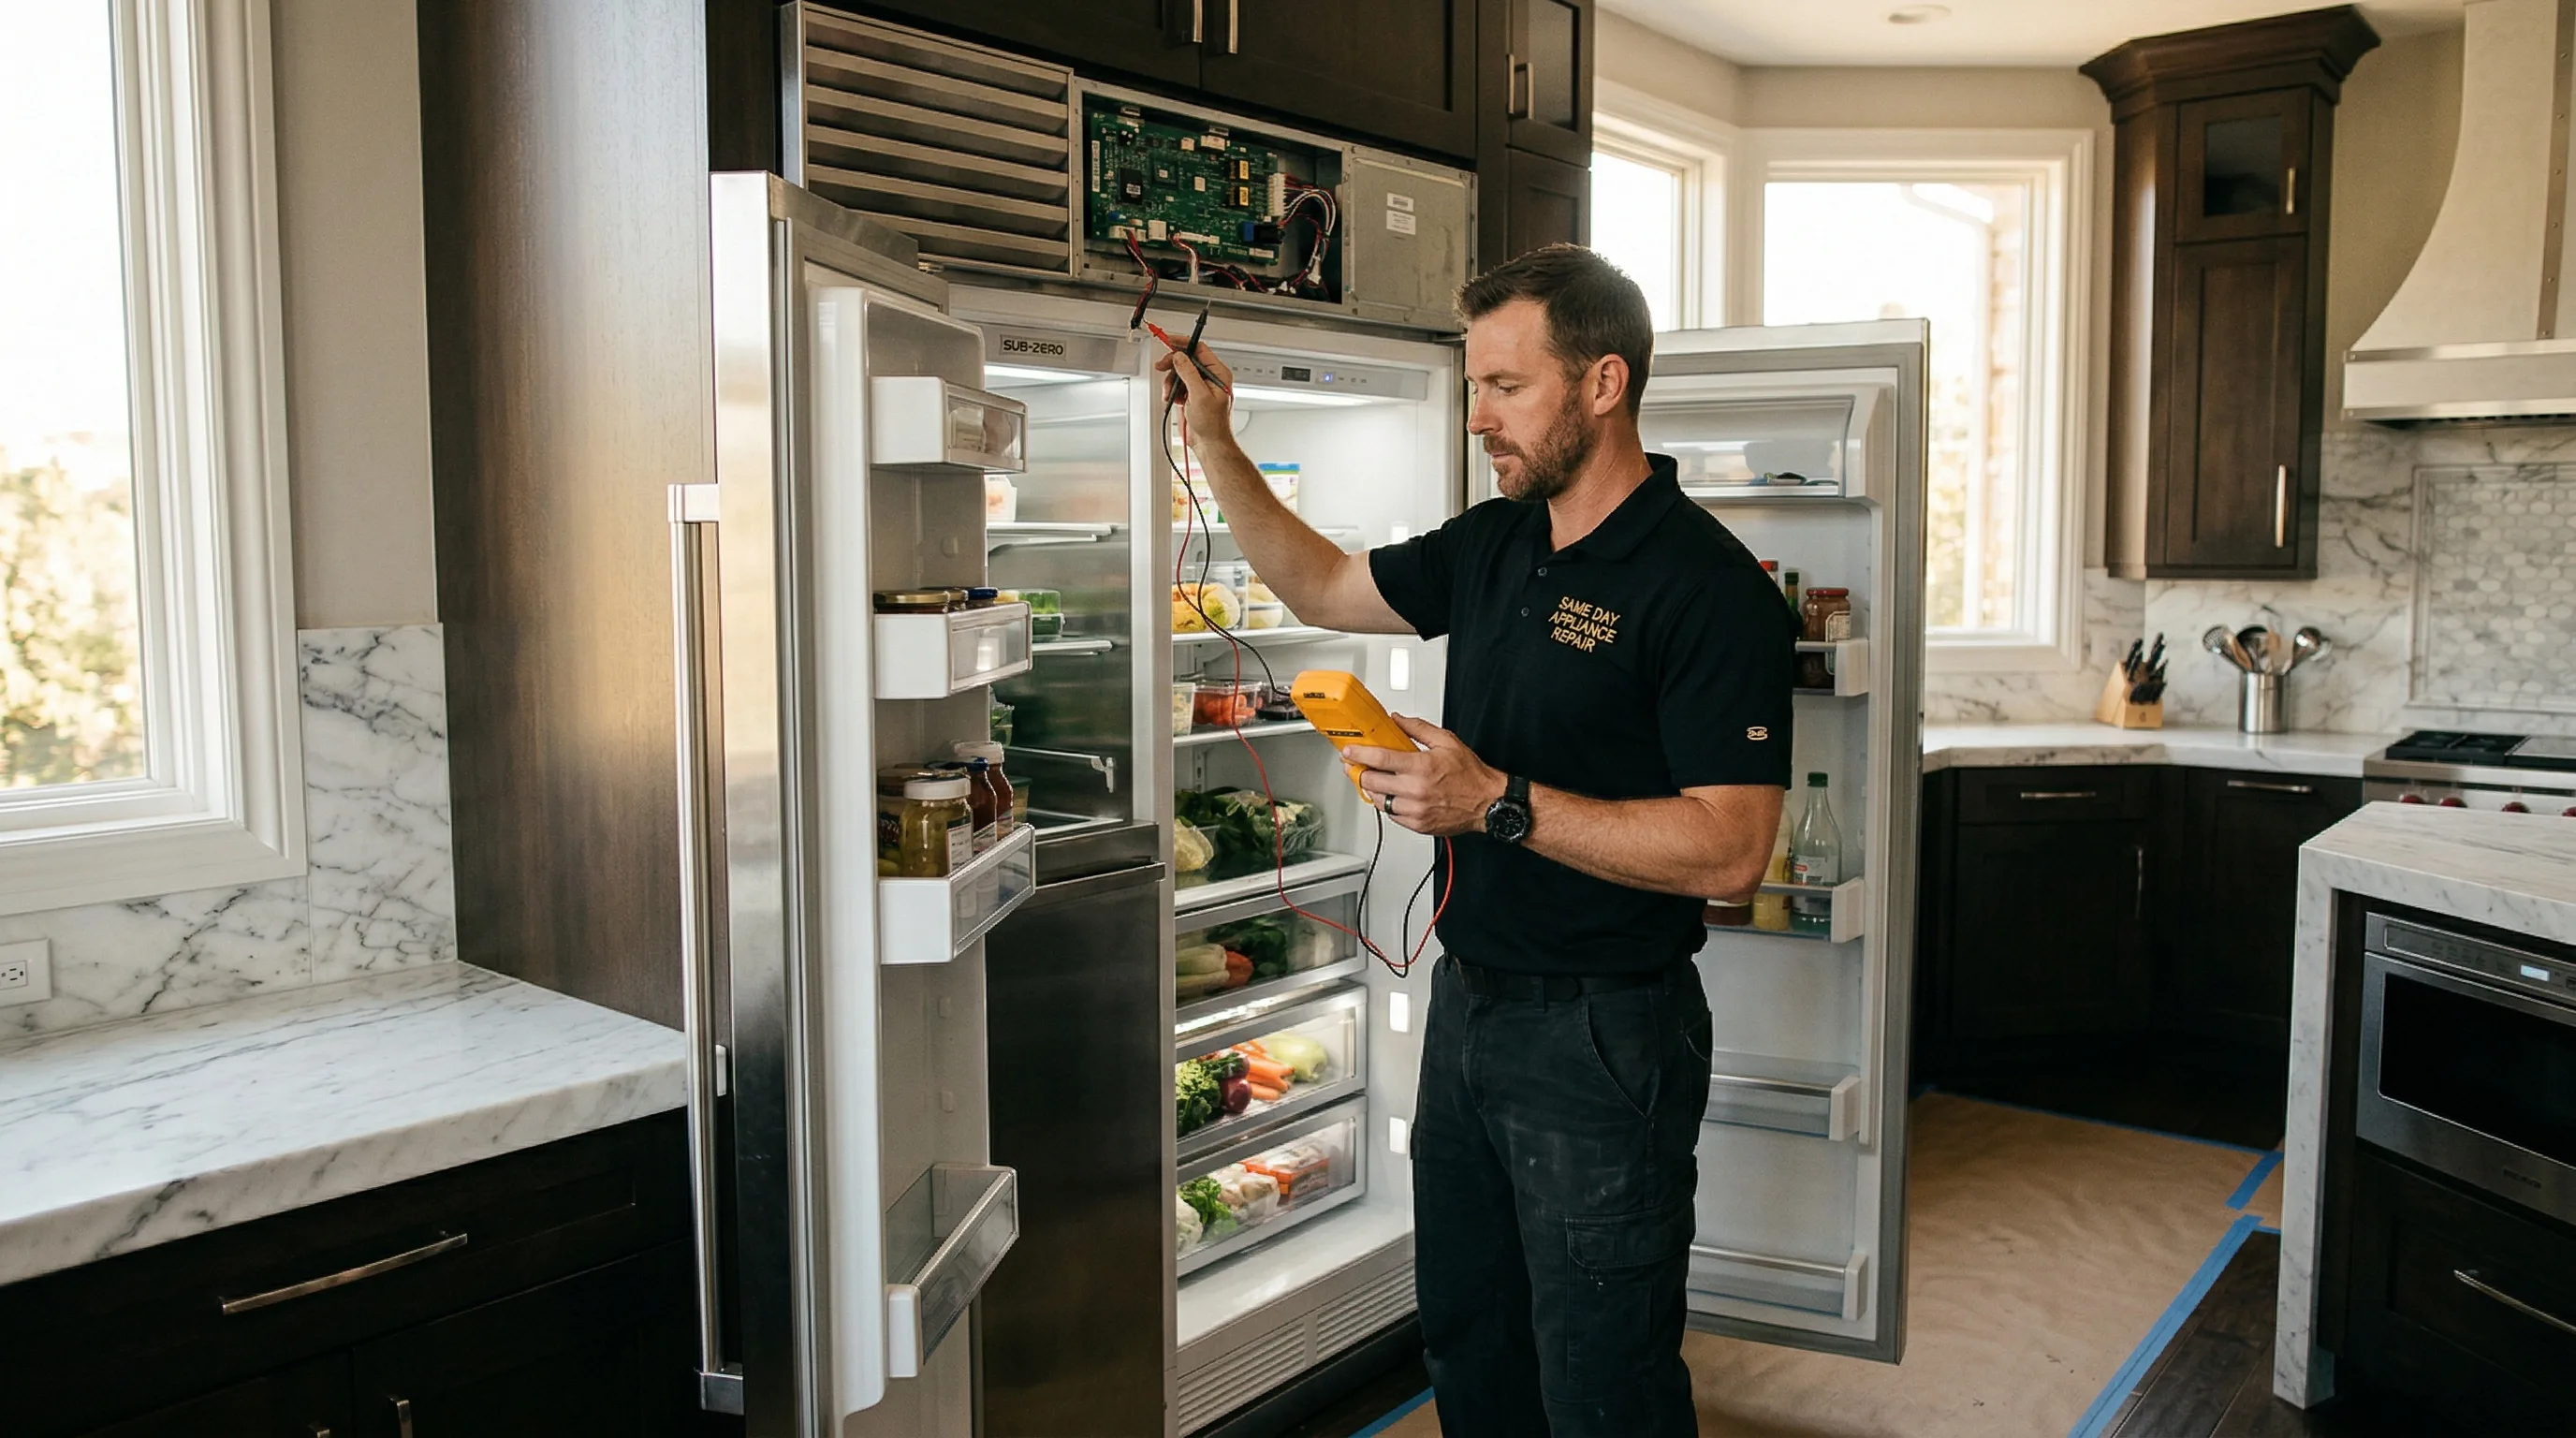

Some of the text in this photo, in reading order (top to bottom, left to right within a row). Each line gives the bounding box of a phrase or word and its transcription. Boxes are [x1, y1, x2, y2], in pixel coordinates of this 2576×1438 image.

[1003, 339, 1064, 355] SUB-ZERO
[1559, 596, 1621, 627] SAME DAY
[1547, 610, 1617, 644] APPLIANCE
[1550, 626, 1596, 653] REPAIR
